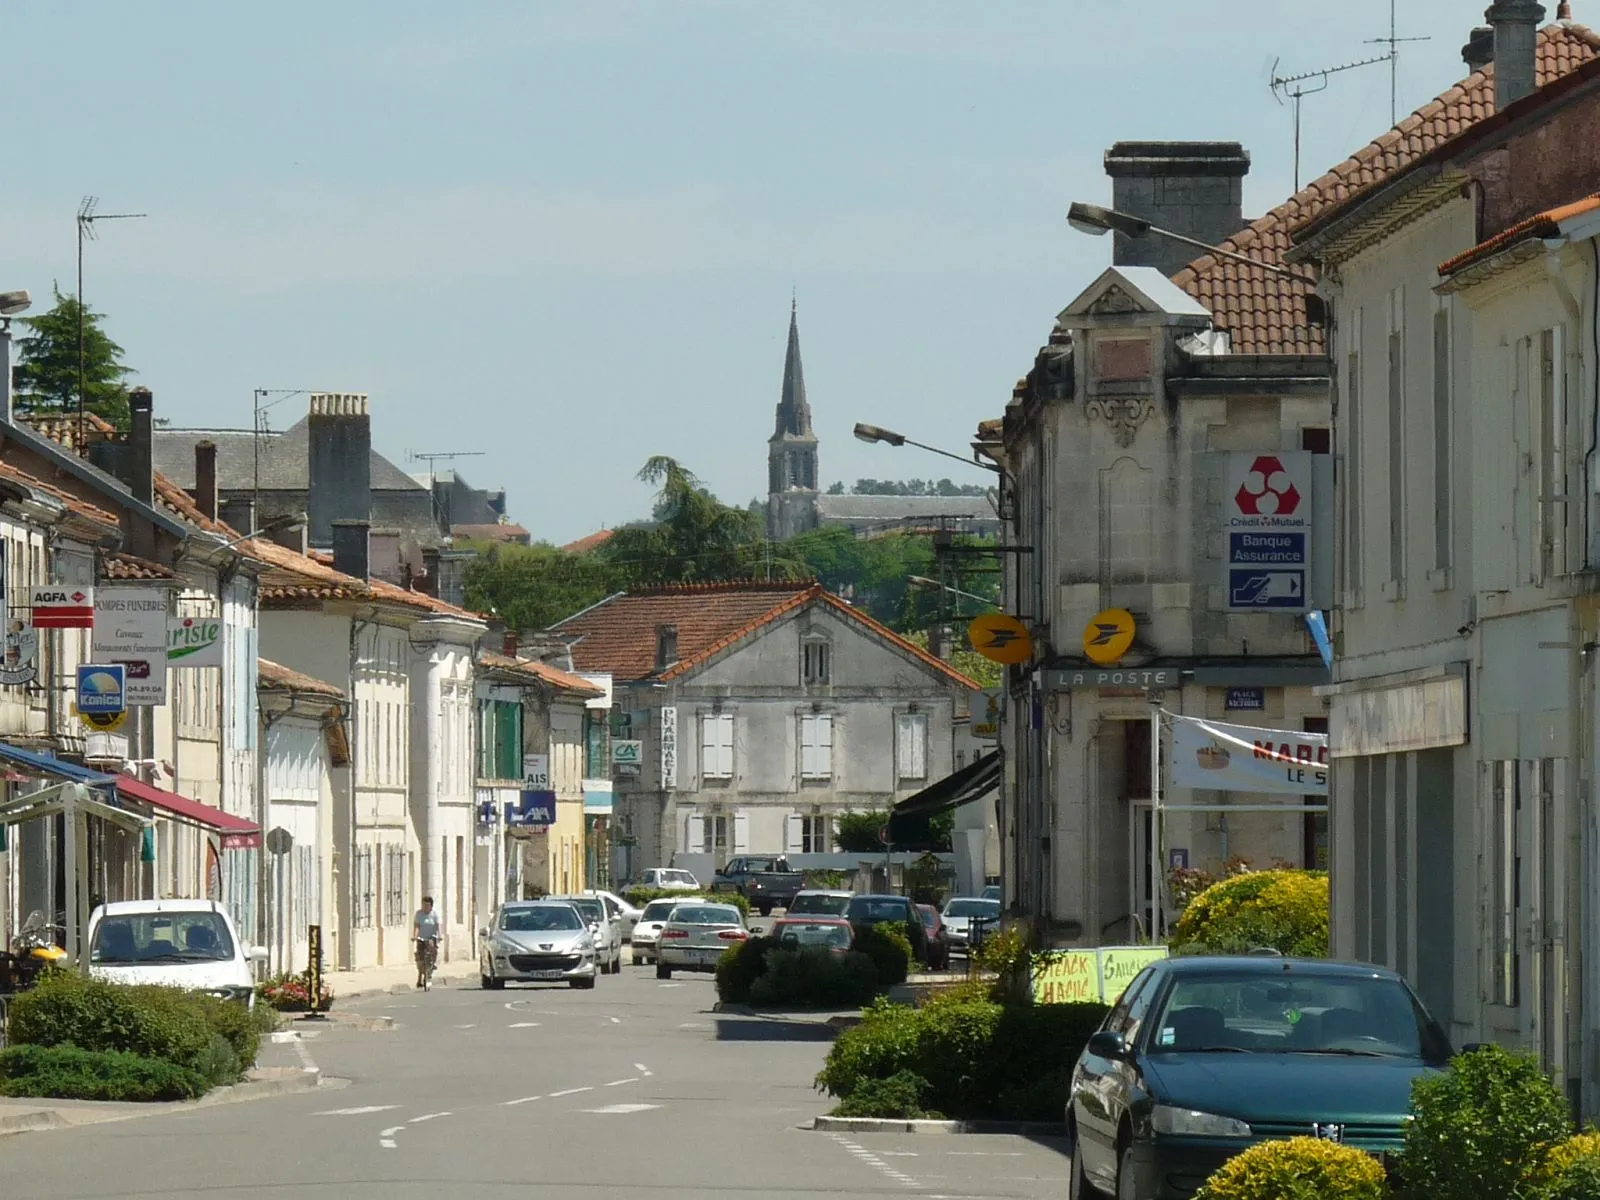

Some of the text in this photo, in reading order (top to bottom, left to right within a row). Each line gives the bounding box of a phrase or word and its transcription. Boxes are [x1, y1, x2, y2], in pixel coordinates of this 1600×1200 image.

[1271, 517, 1305, 527] Mutuel
[1242, 535, 1292, 548] Banque
[1235, 550, 1301, 561] Assurance
[35, 592, 67, 602] AGFA
[94, 600, 125, 611] POMPES
[1059, 672, 1166, 685] LA POSTE
[80, 694, 121, 706] Konica
[663, 708, 675, 786] PHARMACIE
[524, 773, 547, 784] AIS
[1287, 768, 1305, 784] LE
[524, 807, 552, 821] AXA
